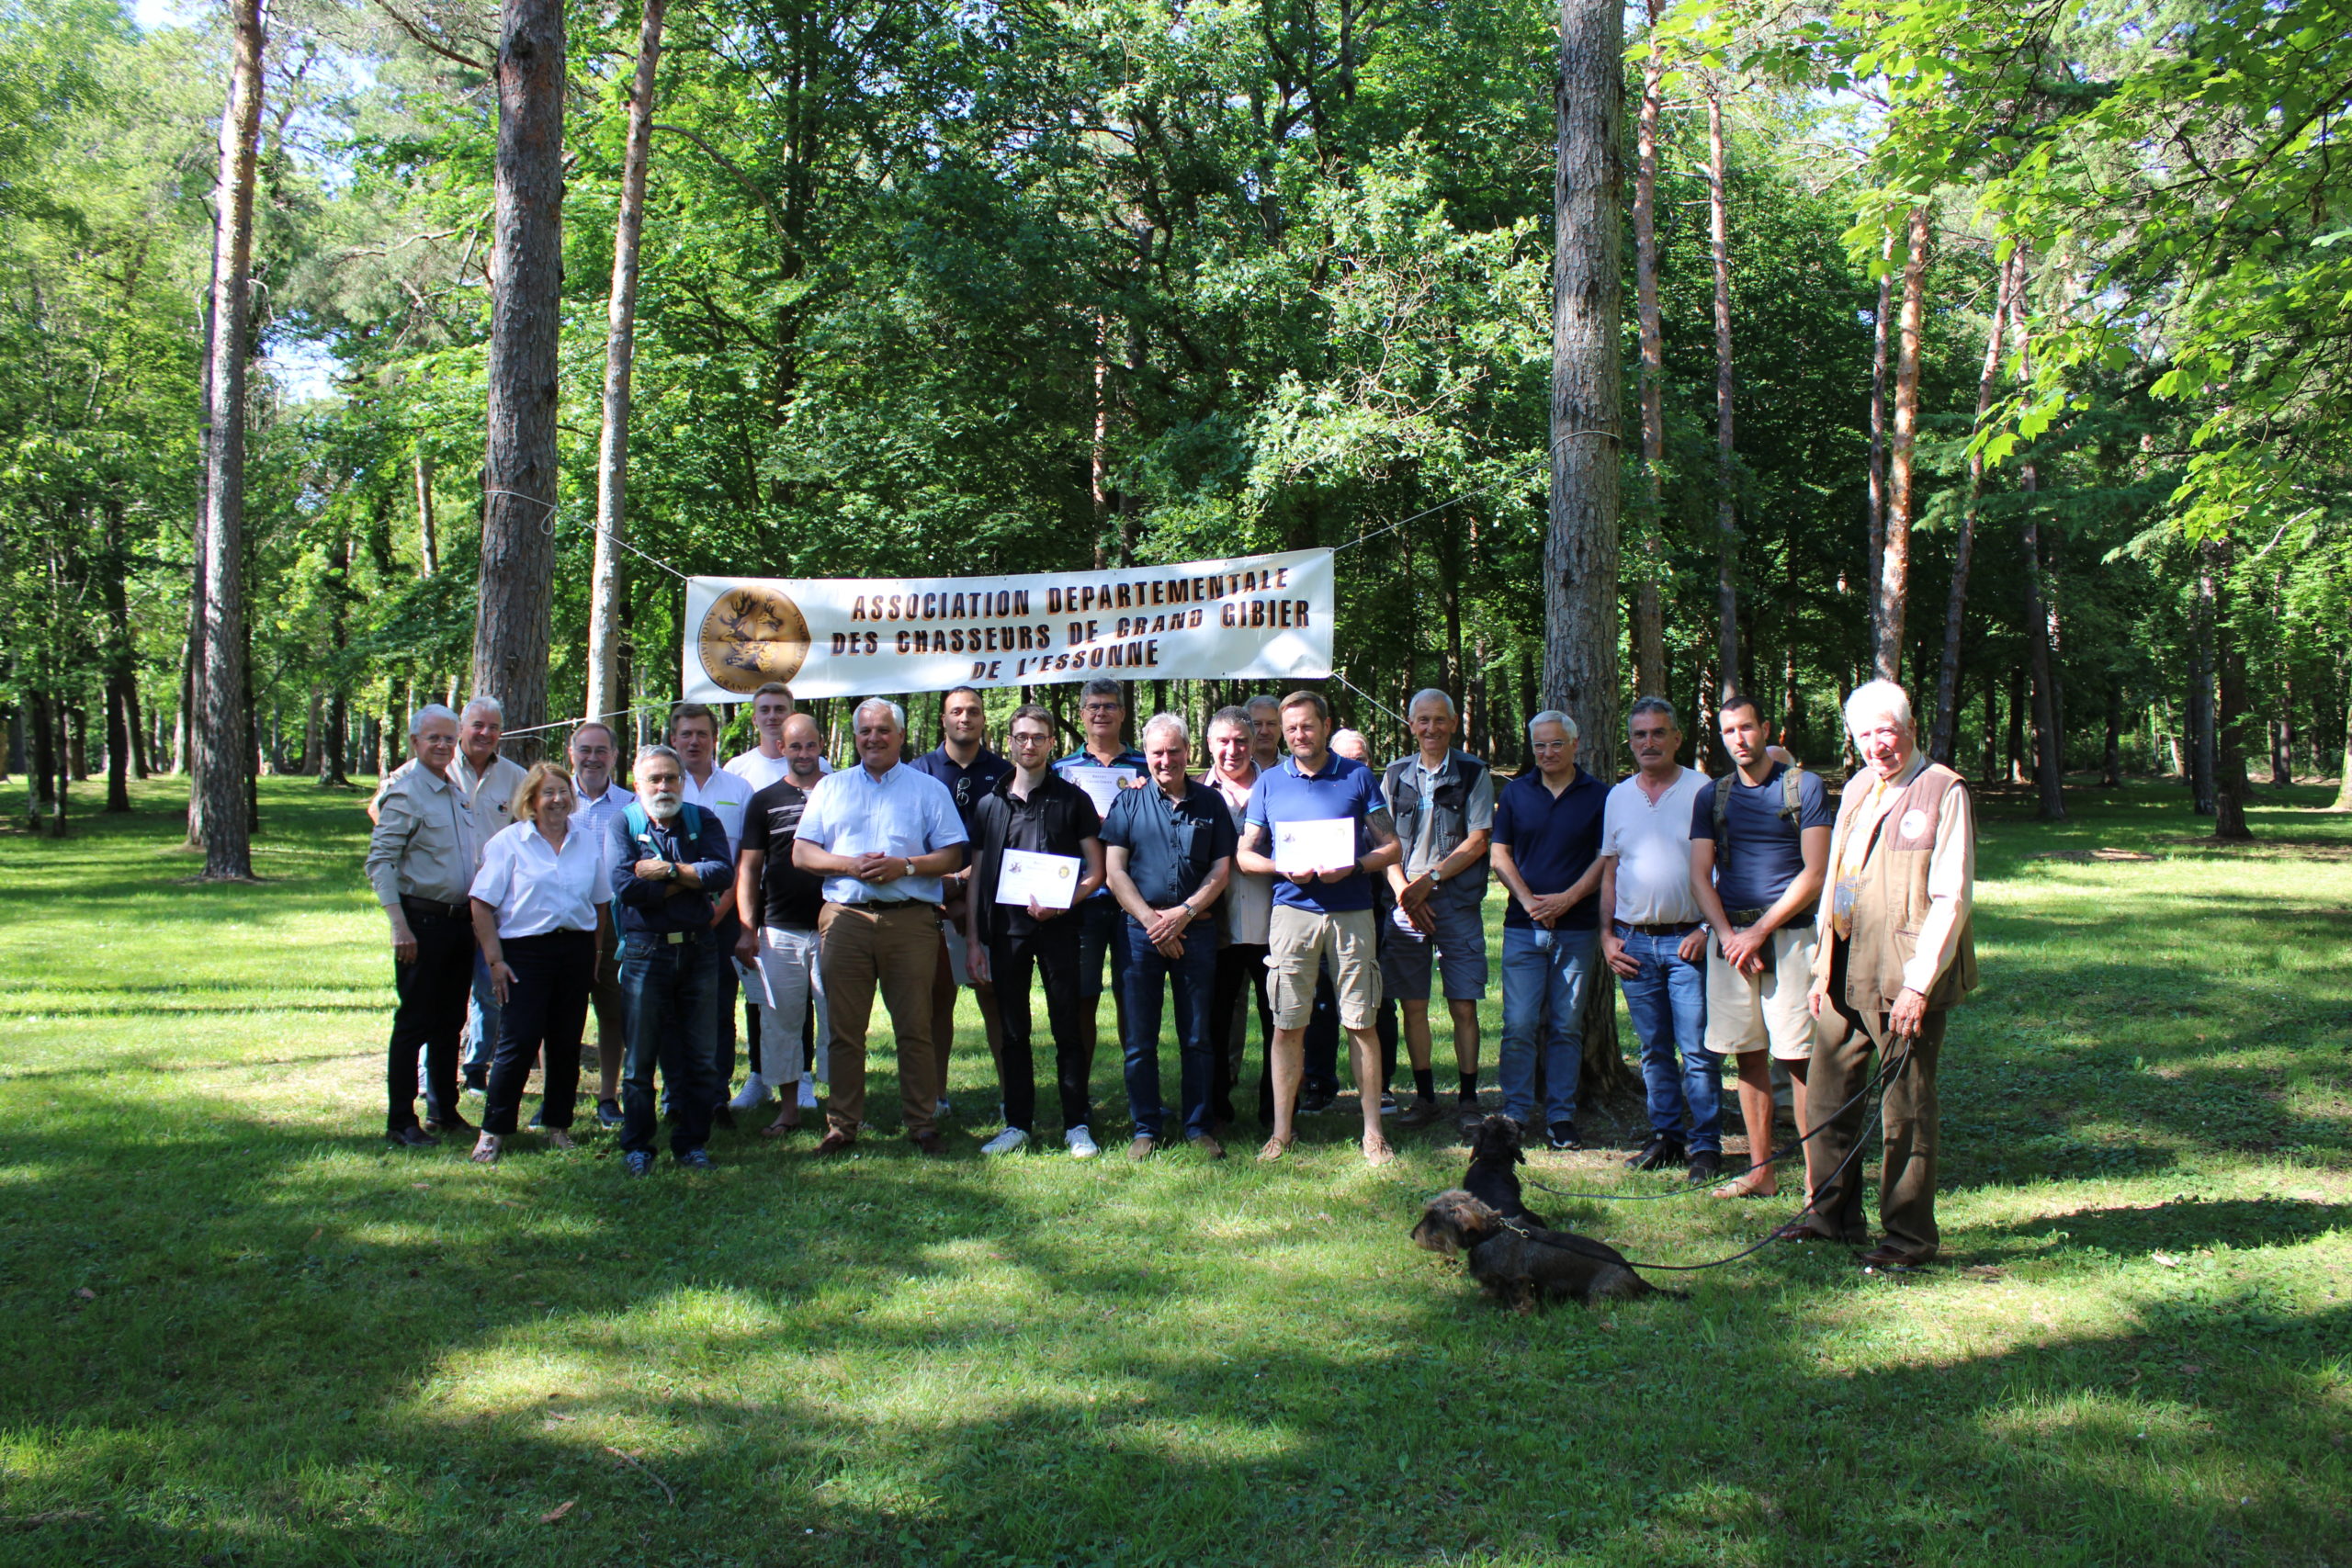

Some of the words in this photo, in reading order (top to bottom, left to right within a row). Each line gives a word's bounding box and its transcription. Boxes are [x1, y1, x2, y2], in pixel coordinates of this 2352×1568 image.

[851, 589, 1030, 622] ASSOCIATION
[1046, 567, 1289, 615] DEPARTEMENTALE
[700, 611, 716, 674] ASSOCIATION
[717, 675, 751, 692] GRAND
[831, 630, 878, 656] DES
[896, 624, 1051, 656] CHASSEURS
[1068, 619, 1099, 648] DE
[1114, 608, 1204, 639] GRAND
[1220, 599, 1309, 629] GIBIER
[969, 660, 1002, 681] DE
[1015, 638, 1159, 678] L'ESSONNE
